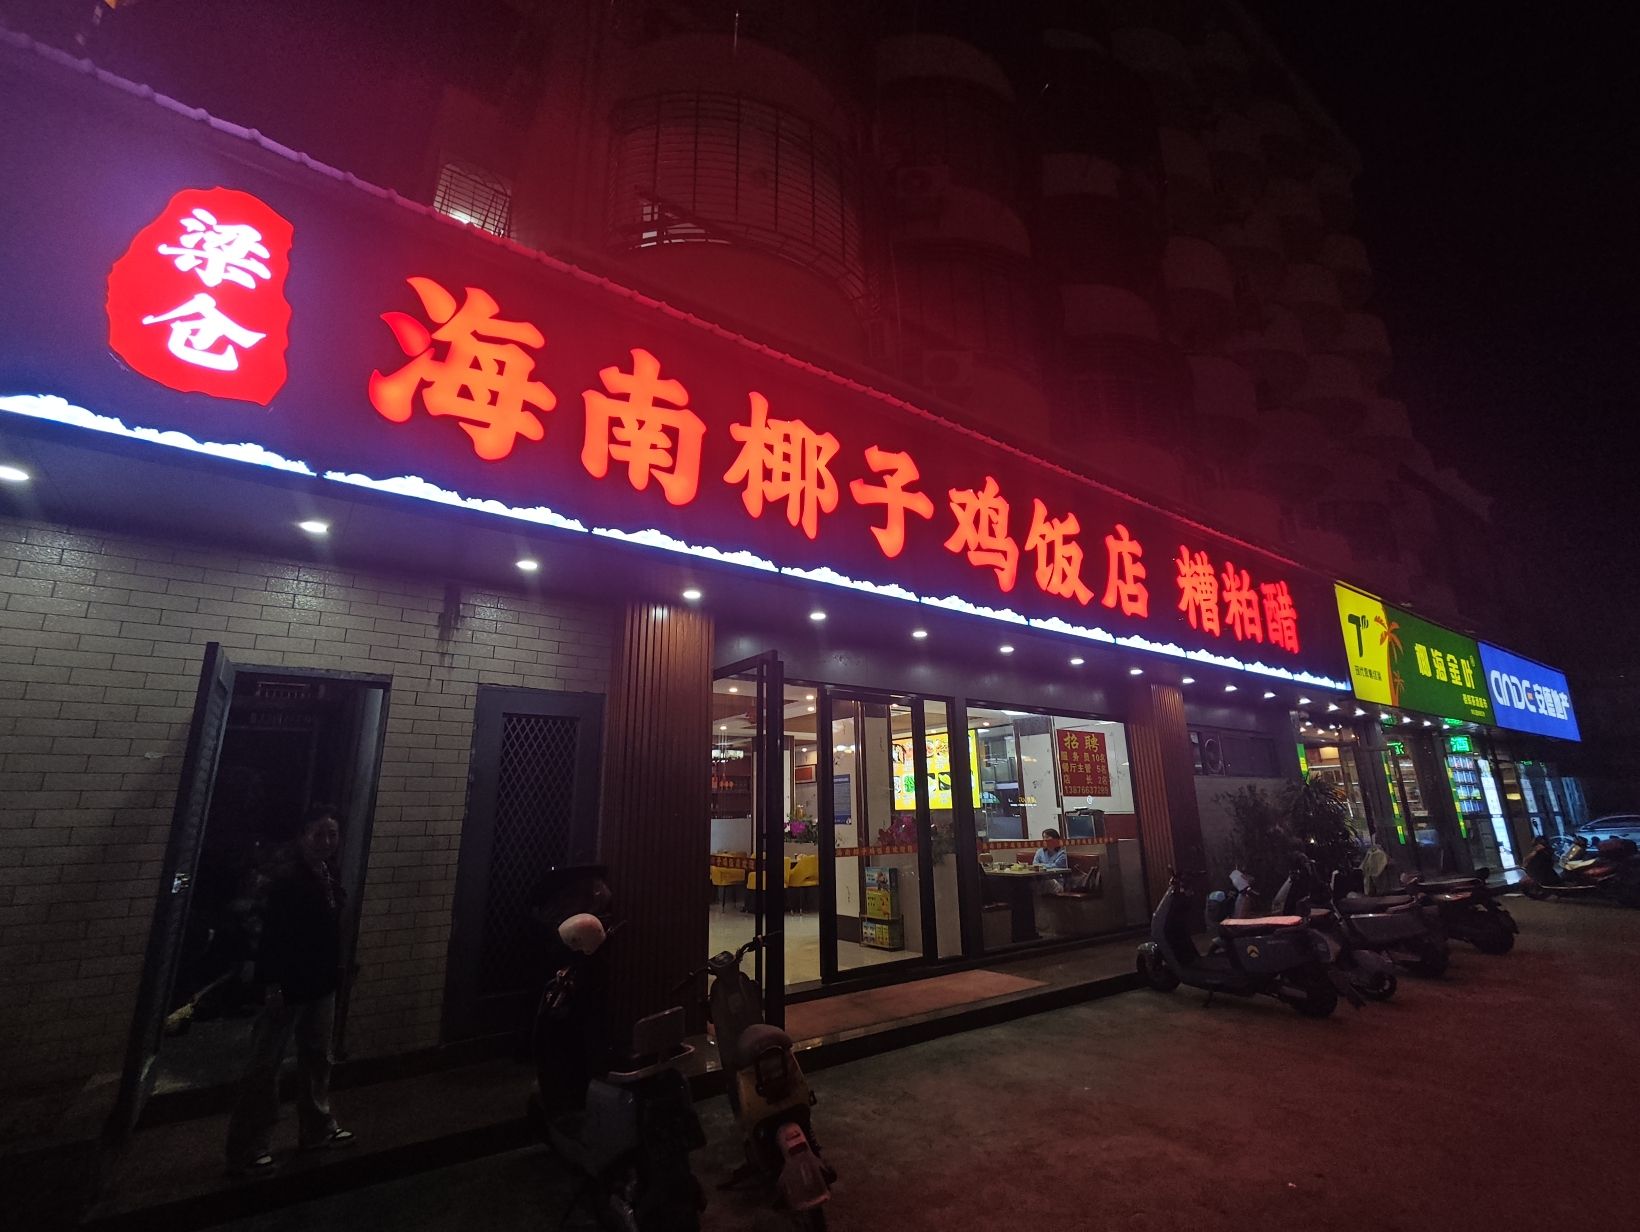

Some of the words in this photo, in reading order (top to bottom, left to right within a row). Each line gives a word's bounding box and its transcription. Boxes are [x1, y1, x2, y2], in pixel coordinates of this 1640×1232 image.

[367, 275, 1149, 620] 海南椰子鸡饭店
[1175, 544, 1299, 654] 糟粕醋
[1063, 732, 1100, 753] 招聘
